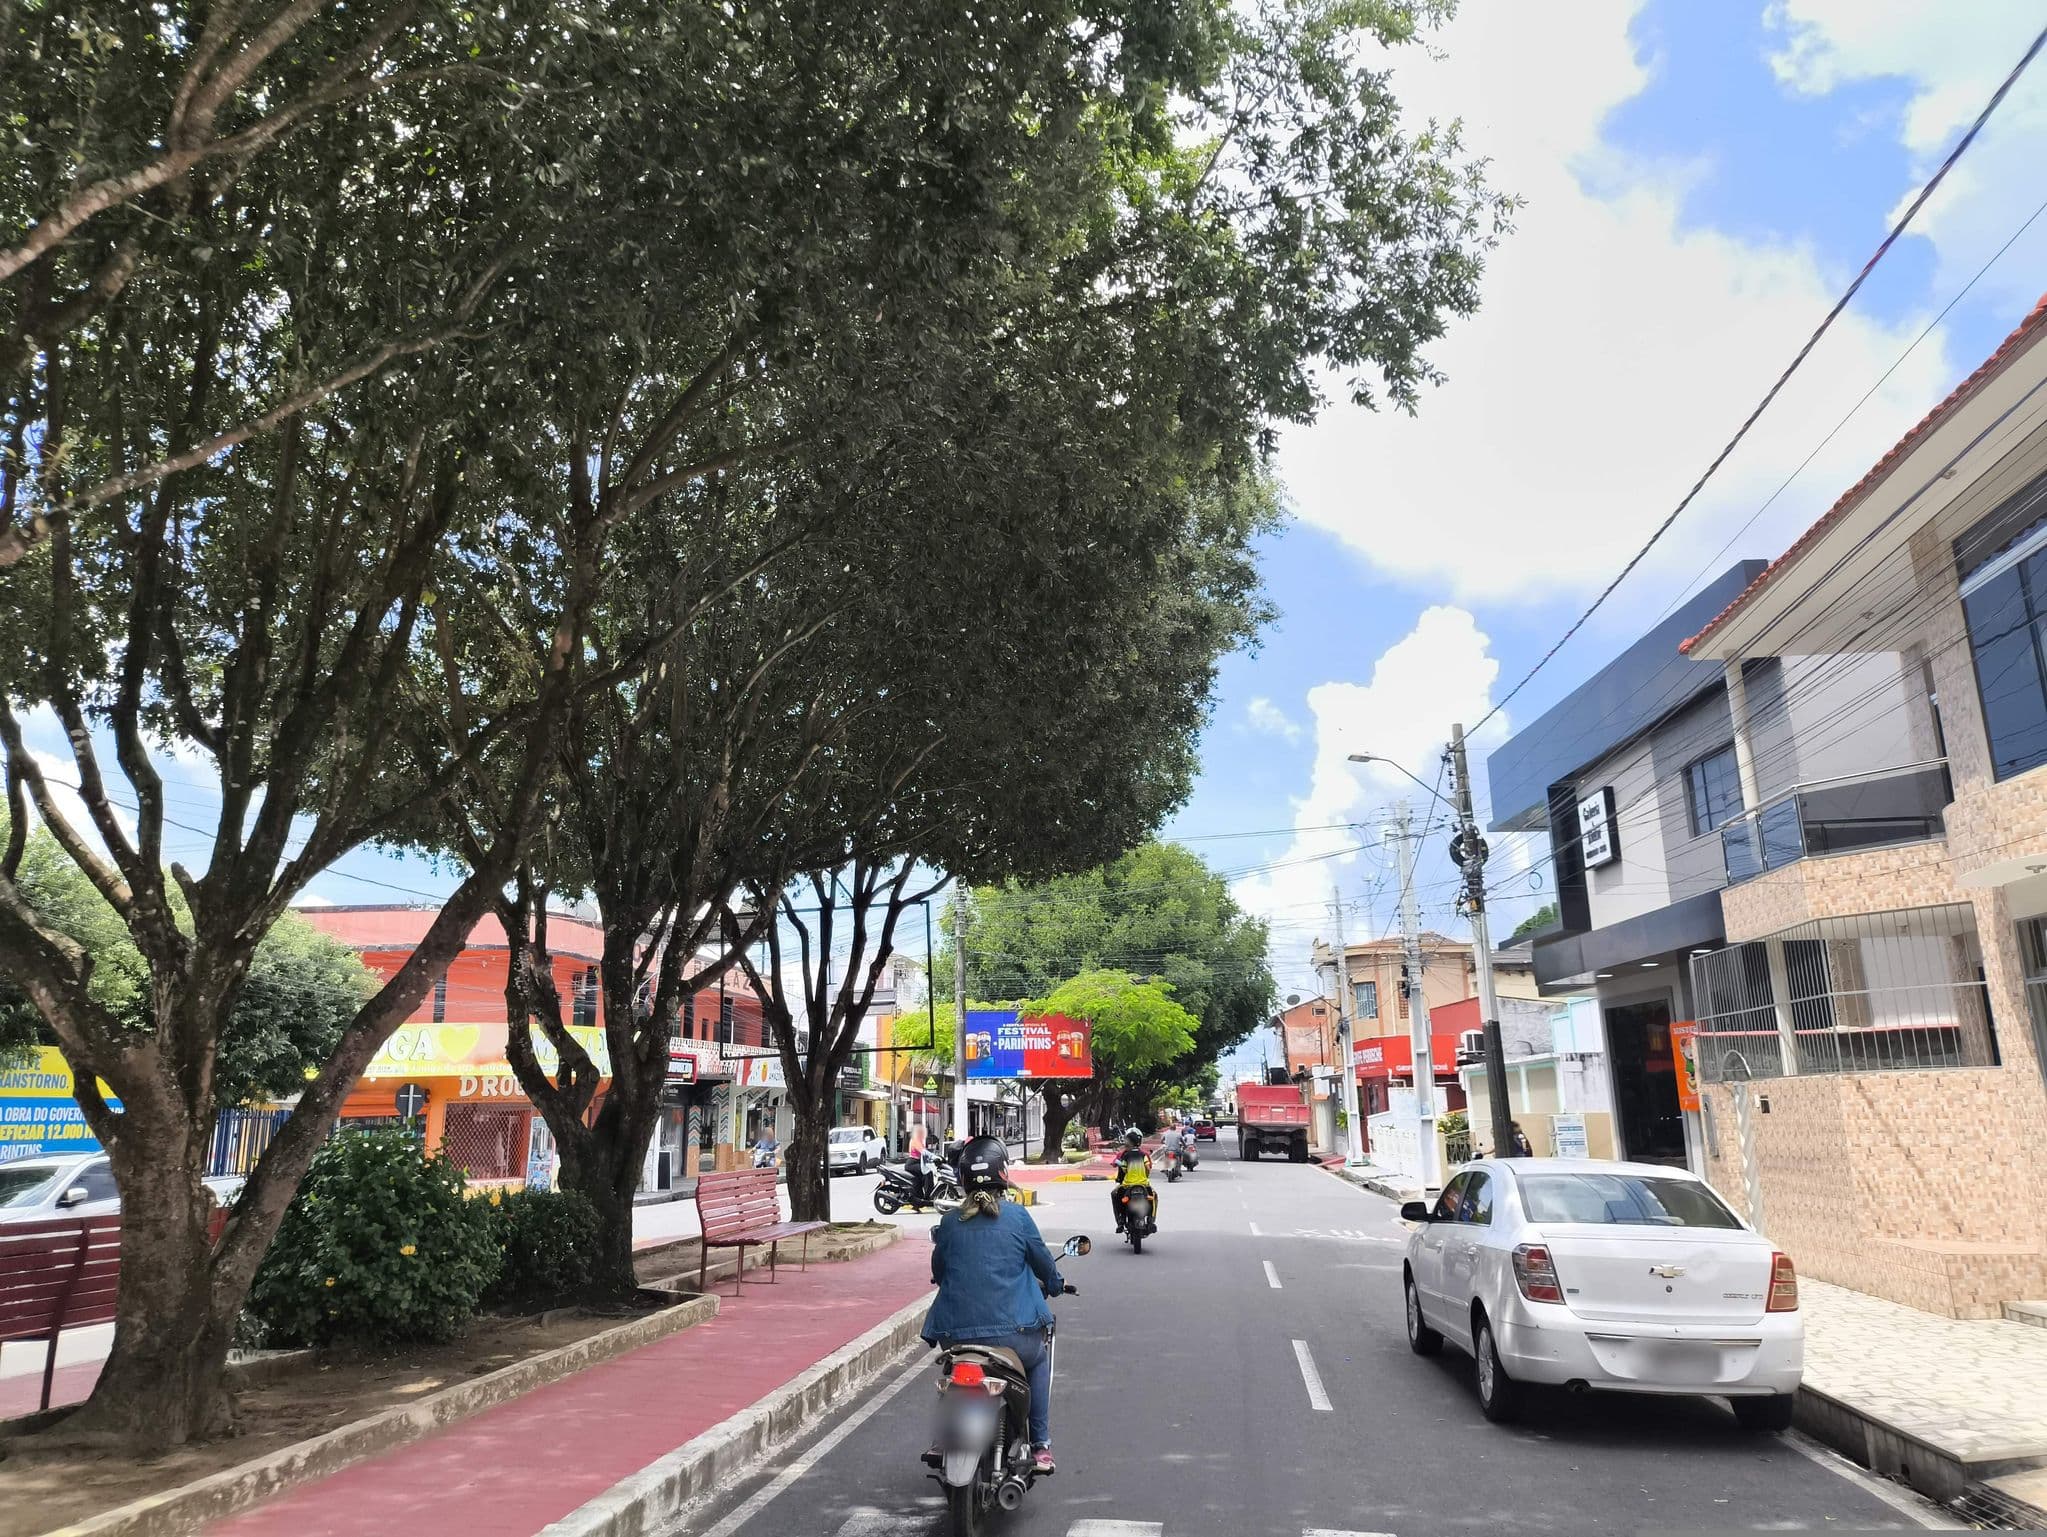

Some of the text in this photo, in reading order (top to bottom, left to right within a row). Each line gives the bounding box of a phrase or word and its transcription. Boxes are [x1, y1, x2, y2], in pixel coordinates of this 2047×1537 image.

[997, 1027, 1051, 1035] FESTIVAL
[998, 1037, 1051, 1050] PARINTINS
[5, 1107, 32, 1121] OBRA
[34, 1107, 48, 1121] DO
[47, 1124, 84, 1140] 12.000
